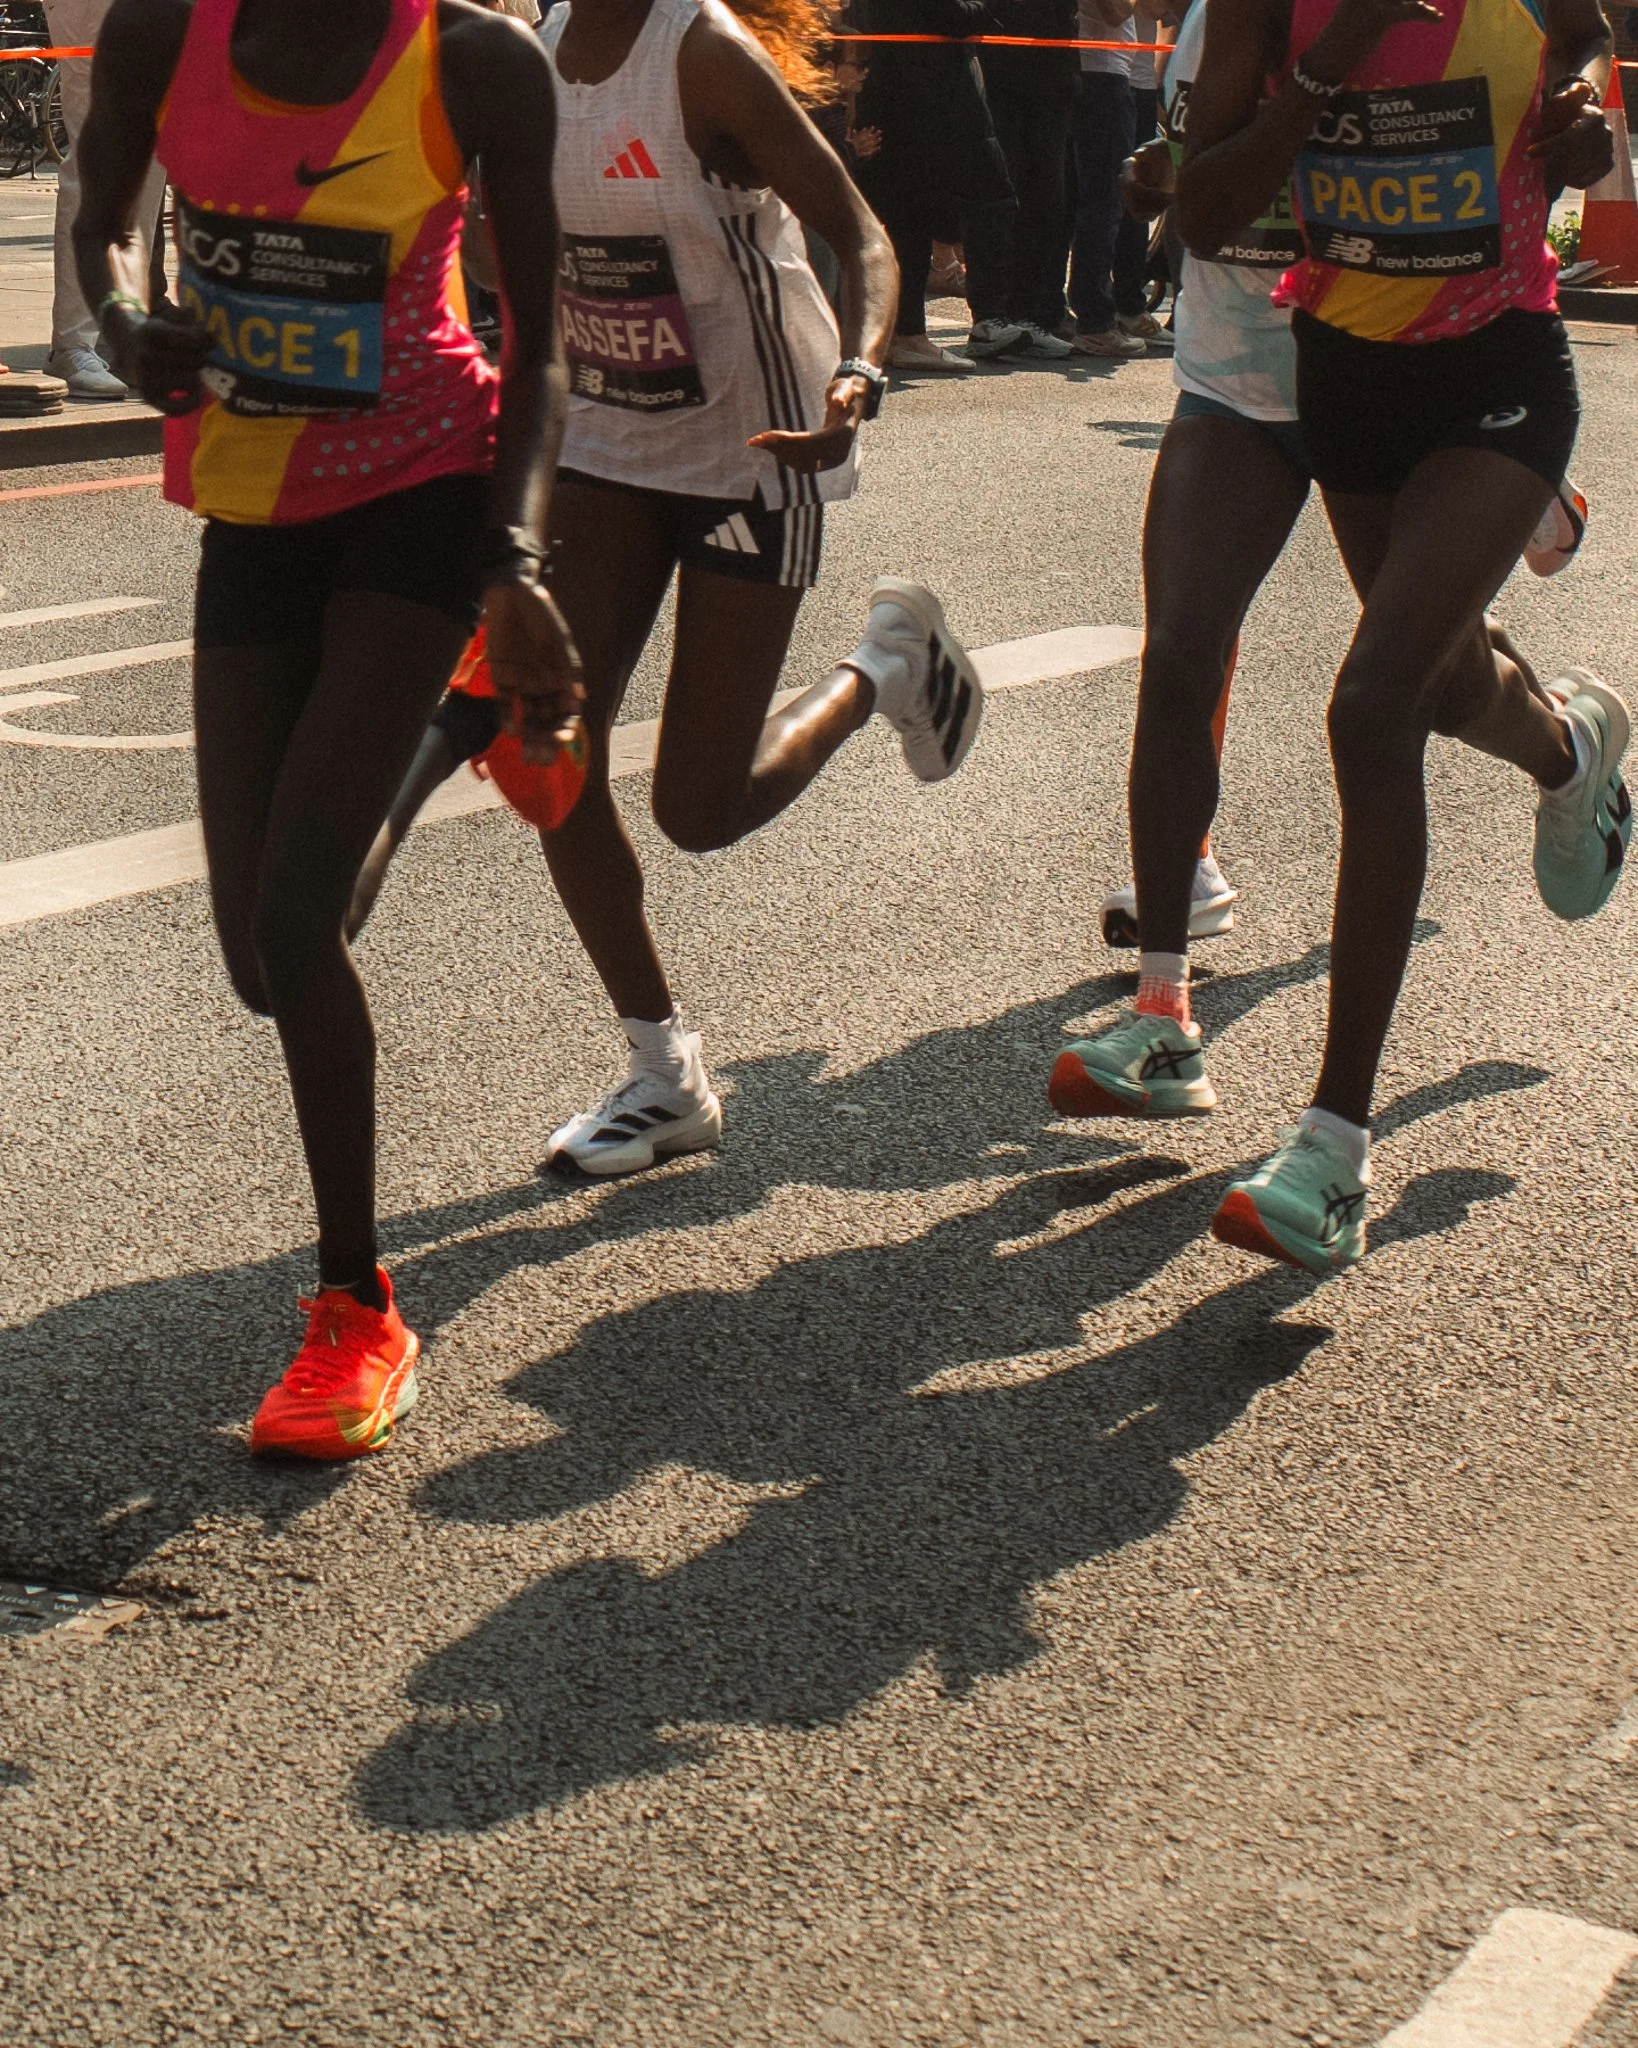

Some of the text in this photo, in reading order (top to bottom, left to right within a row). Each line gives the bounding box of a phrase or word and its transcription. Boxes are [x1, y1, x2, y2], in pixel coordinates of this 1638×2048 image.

[1368, 100, 1414, 115] TATA
[1368, 107, 1476, 131] CONSULTANCY
[1370, 128, 1440, 146] SERVICES
[1311, 171, 1441, 225] PACE
[1452, 170, 1486, 220] 2
[253, 233, 304, 250] TATA
[575, 246, 608, 258] TATA
[1235, 245, 1296, 261] balance
[1376, 251, 1483, 270] new balance
[251, 251, 370, 275] CONSULTANCY
[578, 259, 659, 273] CONSULTANCY
[249, 267, 326, 287] SERVICES
[581, 273, 630, 288] SERVICES
[562, 304, 687, 362] ASSEFA
[333, 328, 360, 379] 1
[237, 396, 273, 412] new
